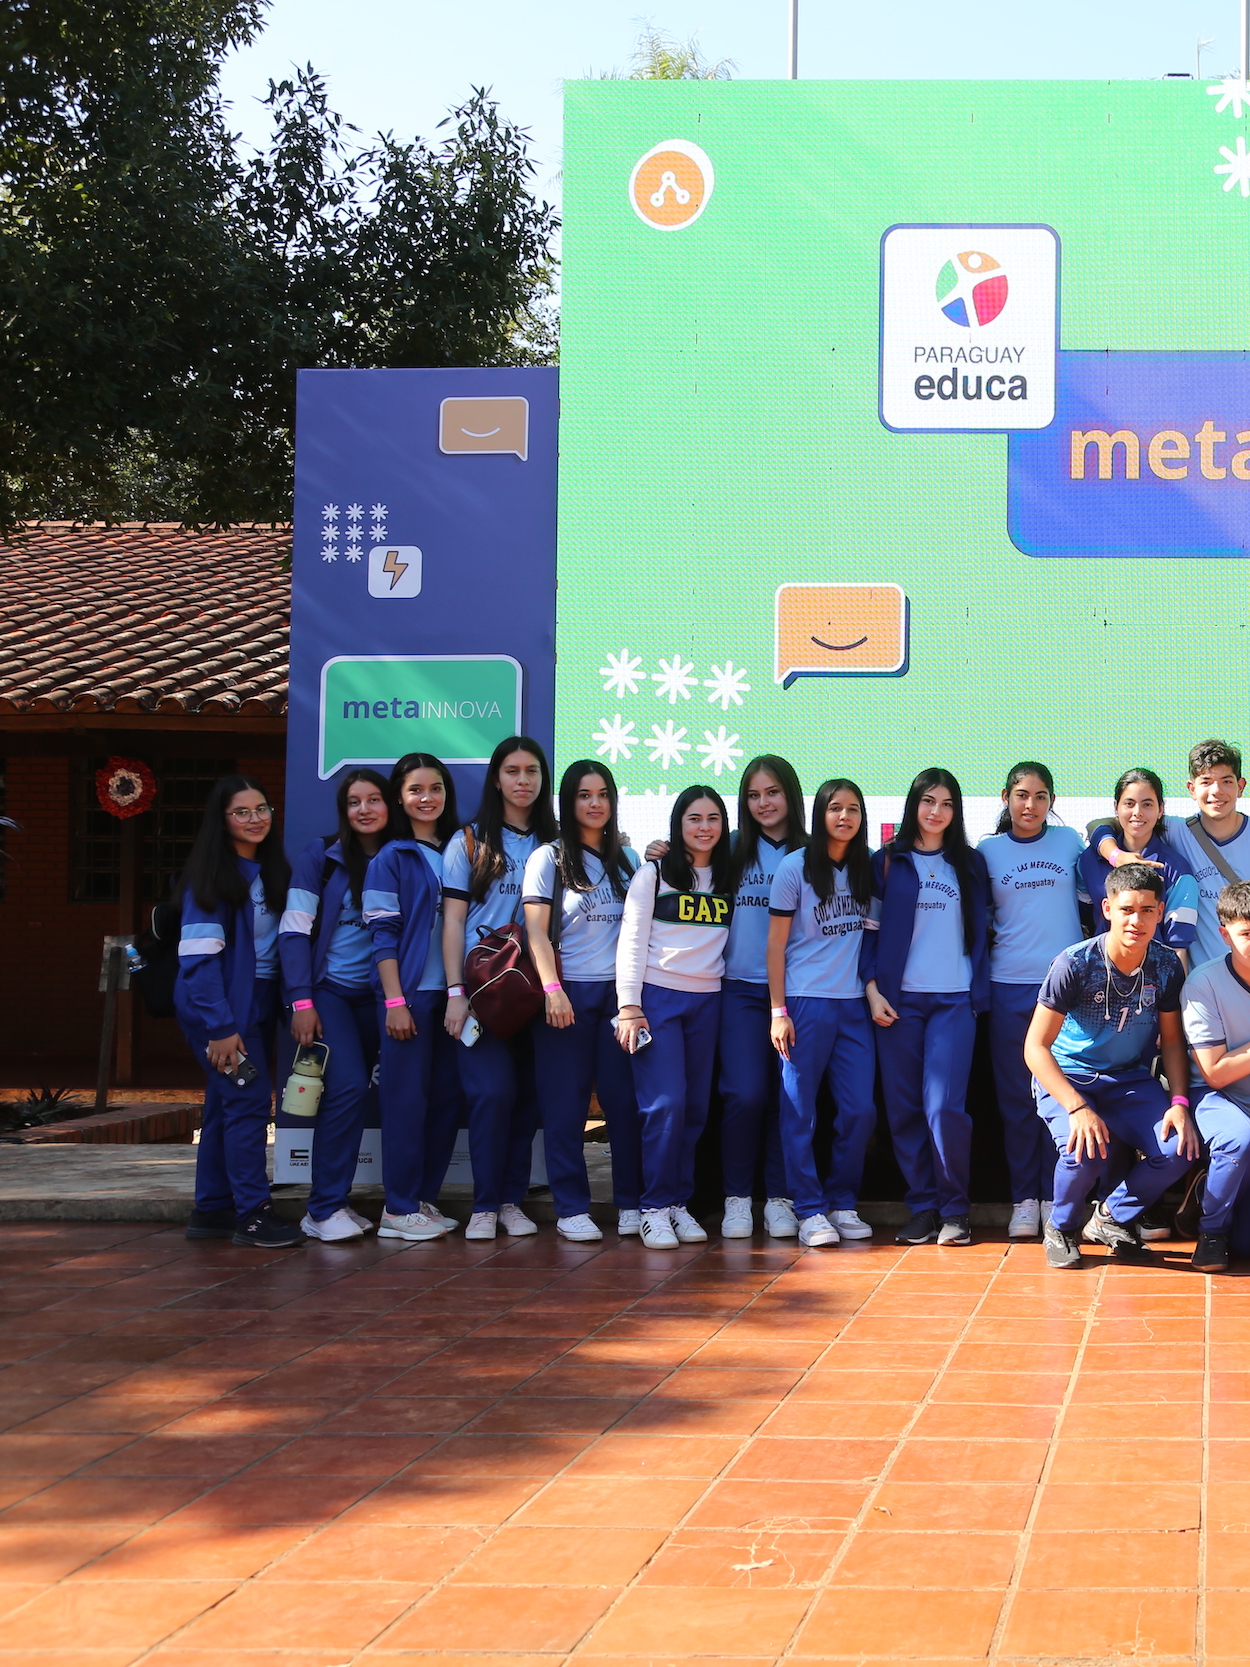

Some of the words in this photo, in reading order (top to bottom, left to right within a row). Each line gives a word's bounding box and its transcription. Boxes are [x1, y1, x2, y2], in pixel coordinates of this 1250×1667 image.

[914, 346, 1026, 364] PARAGUAY
[914, 367, 1028, 401] educa
[1014, 879, 1056, 890] Caraguatay
[678, 895, 729, 923] GAP
[916, 901, 947, 911] raguatay
[1117, 1006, 1129, 1033] 1
